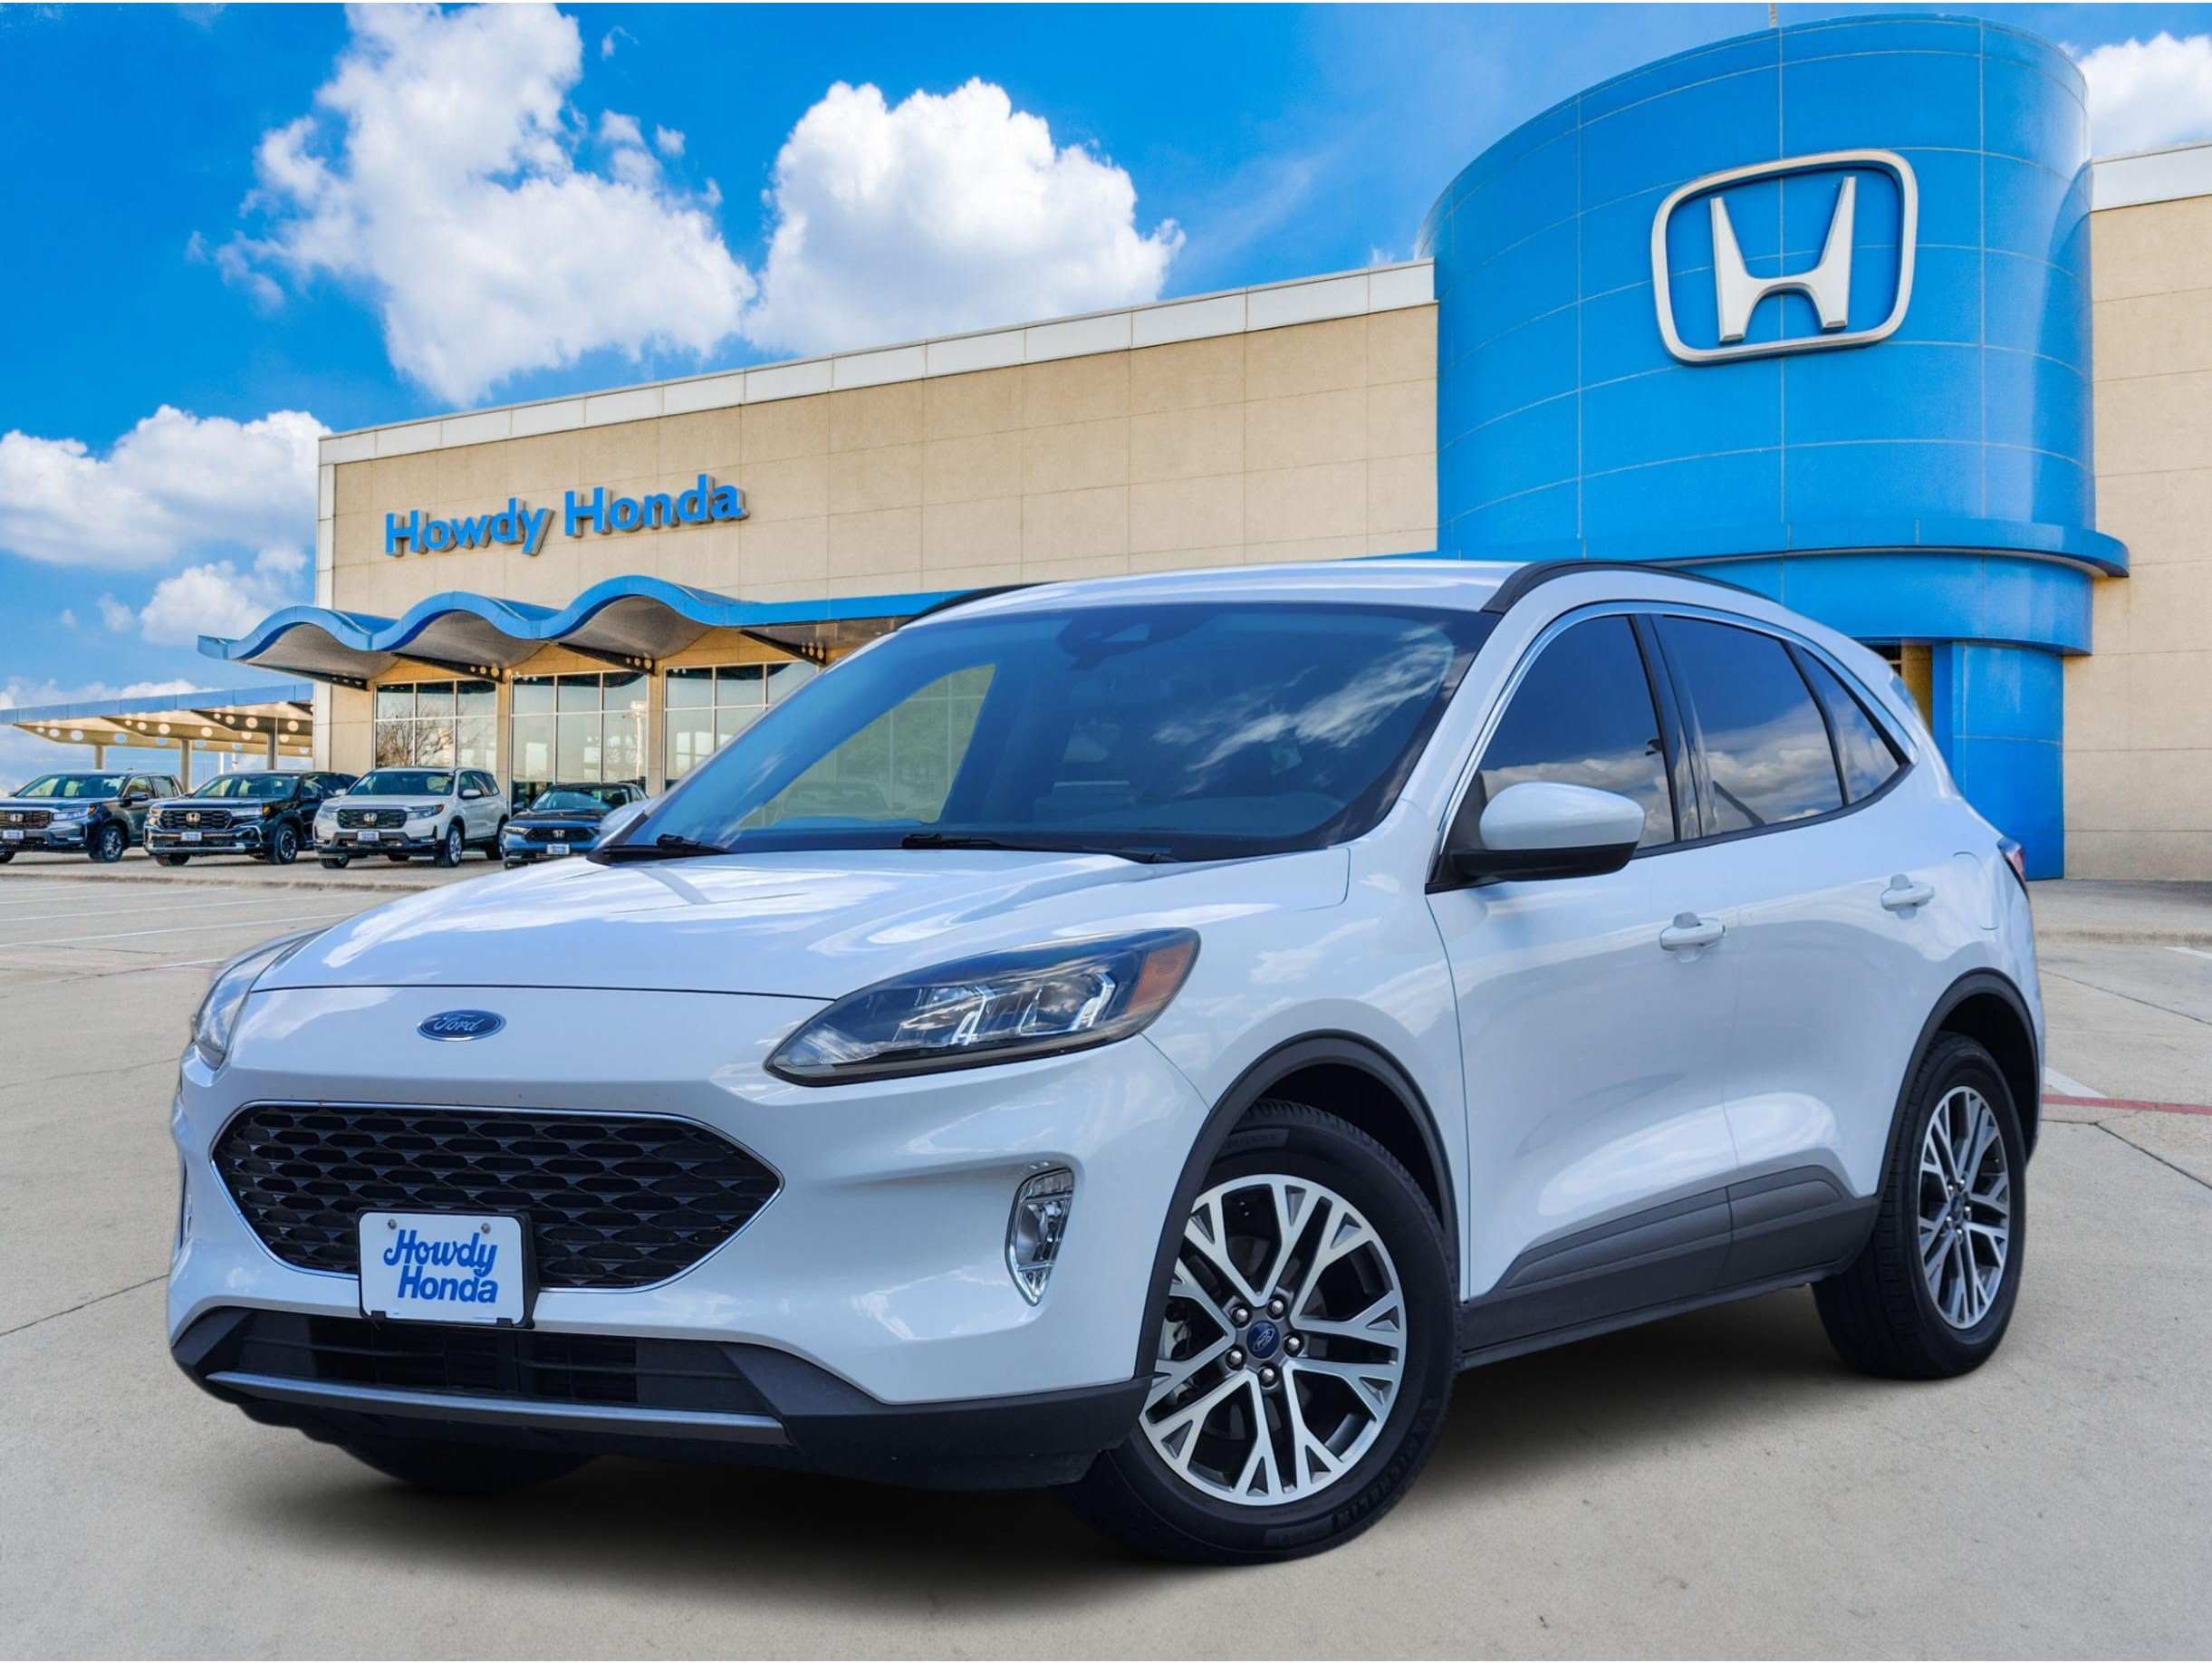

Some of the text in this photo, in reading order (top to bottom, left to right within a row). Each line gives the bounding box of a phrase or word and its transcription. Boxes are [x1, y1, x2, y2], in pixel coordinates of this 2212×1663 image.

[385, 474, 749, 556] Howdy Honda
[383, 1229, 497, 1277] Howdy
[398, 1265, 498, 1303] Honda
